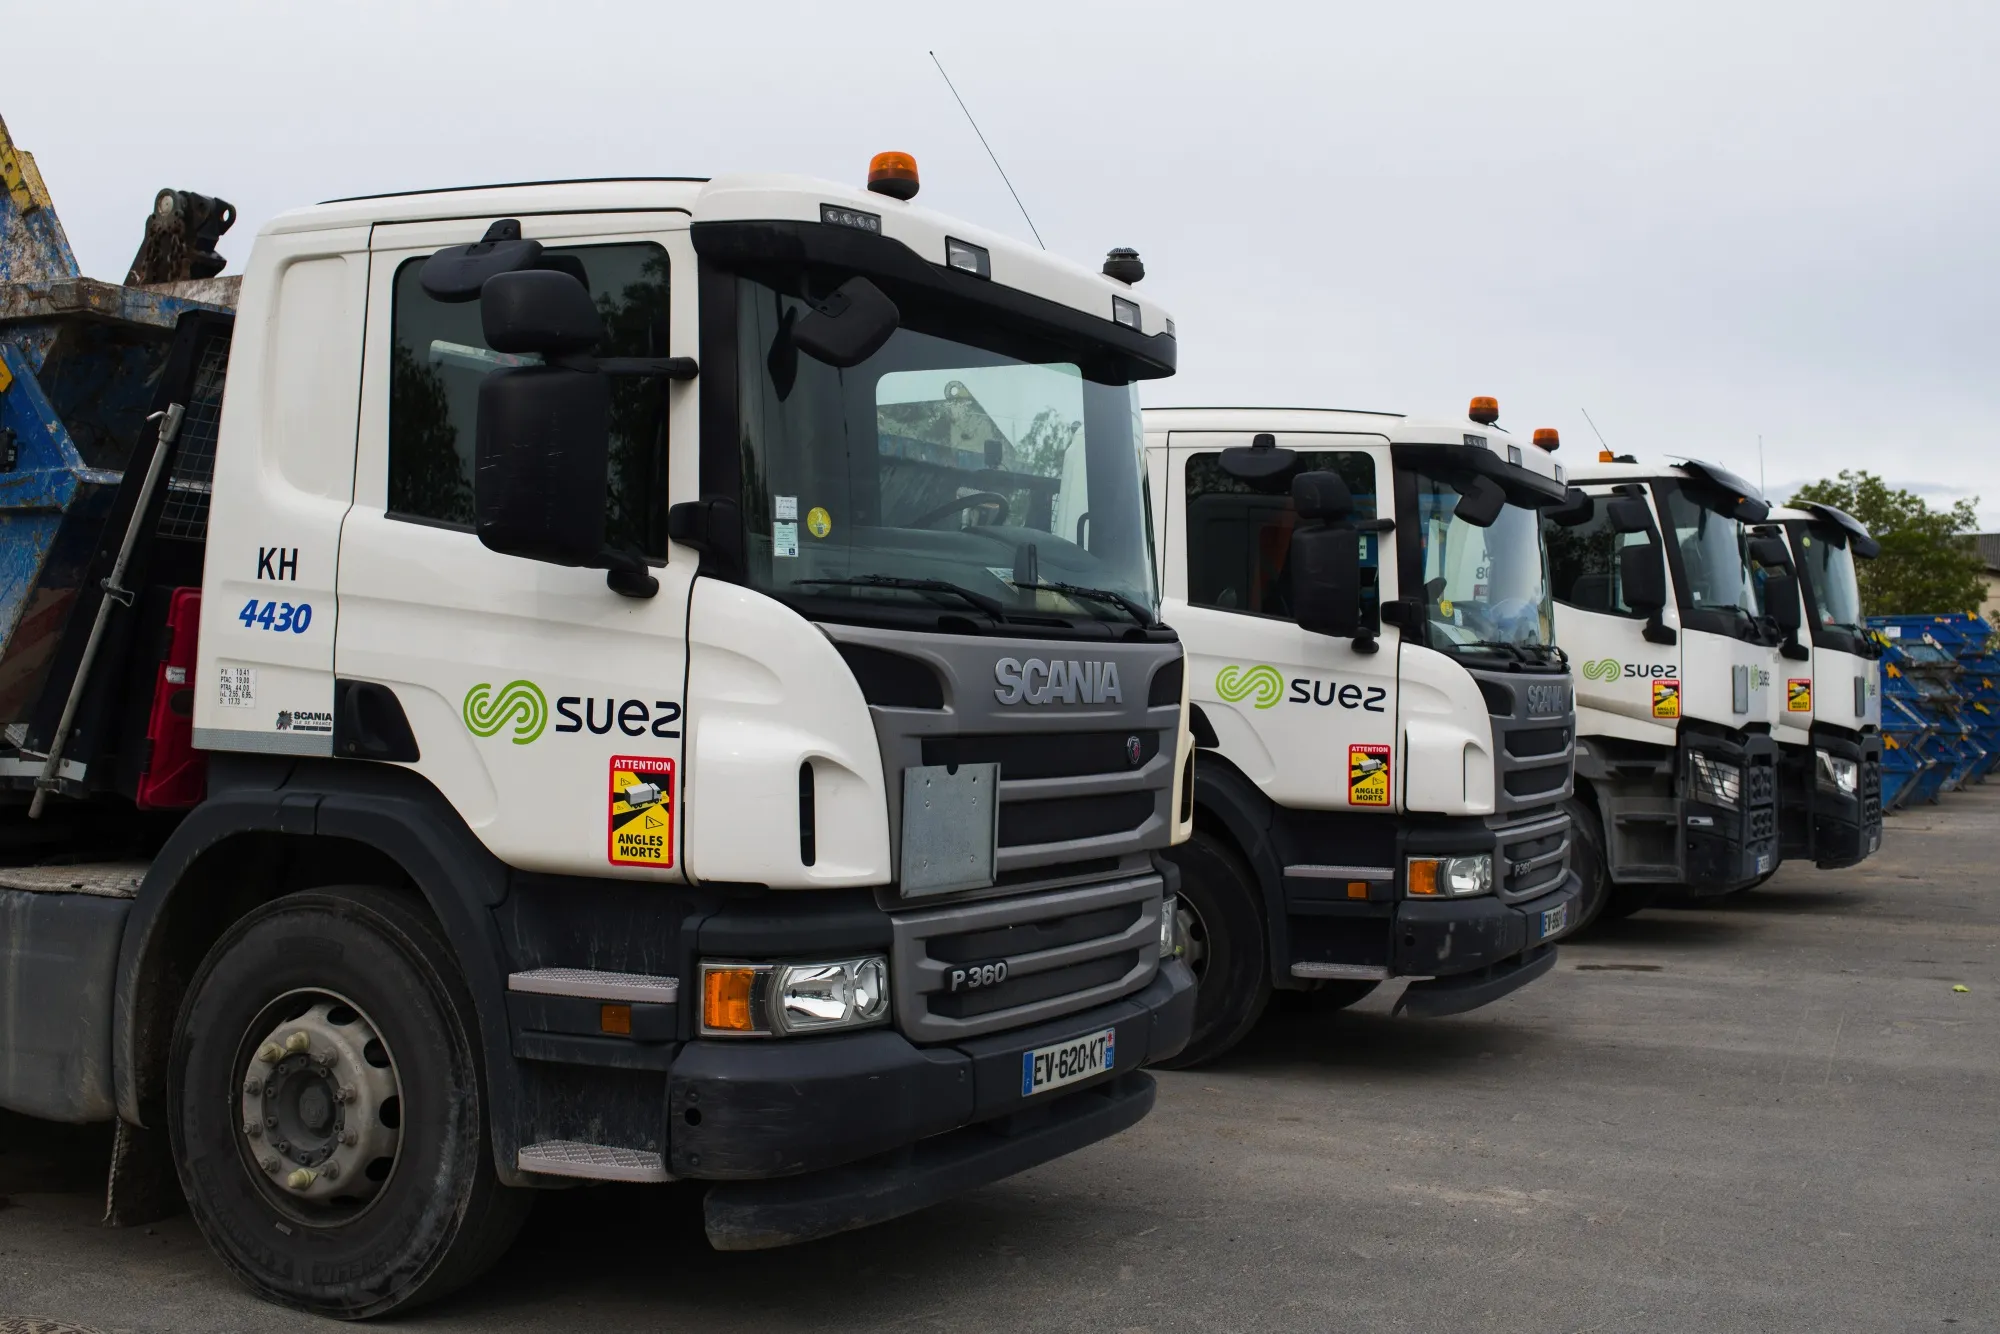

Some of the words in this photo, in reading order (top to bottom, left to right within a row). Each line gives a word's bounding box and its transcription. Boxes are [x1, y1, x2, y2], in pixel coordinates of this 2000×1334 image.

[257, 547, 298, 581] KH
[239, 599, 312, 634] 4430
[994, 657, 1123, 705] SCANIA
[1288, 678, 1387, 713] suez
[294, 711, 332, 722] SCANIA
[555, 696, 682, 739] suez
[613, 759, 671, 771] ATTENTION
[1354, 787, 1384, 795] ANGLES
[1356, 794, 1383, 802] MORTS
[617, 833, 664, 847] ANGLES
[620, 845, 661, 859] MORTS
[952, 969, 966, 993] P
[968, 962, 1007, 988] 360
[1033, 1036, 1106, 1087] EV-620-KT
